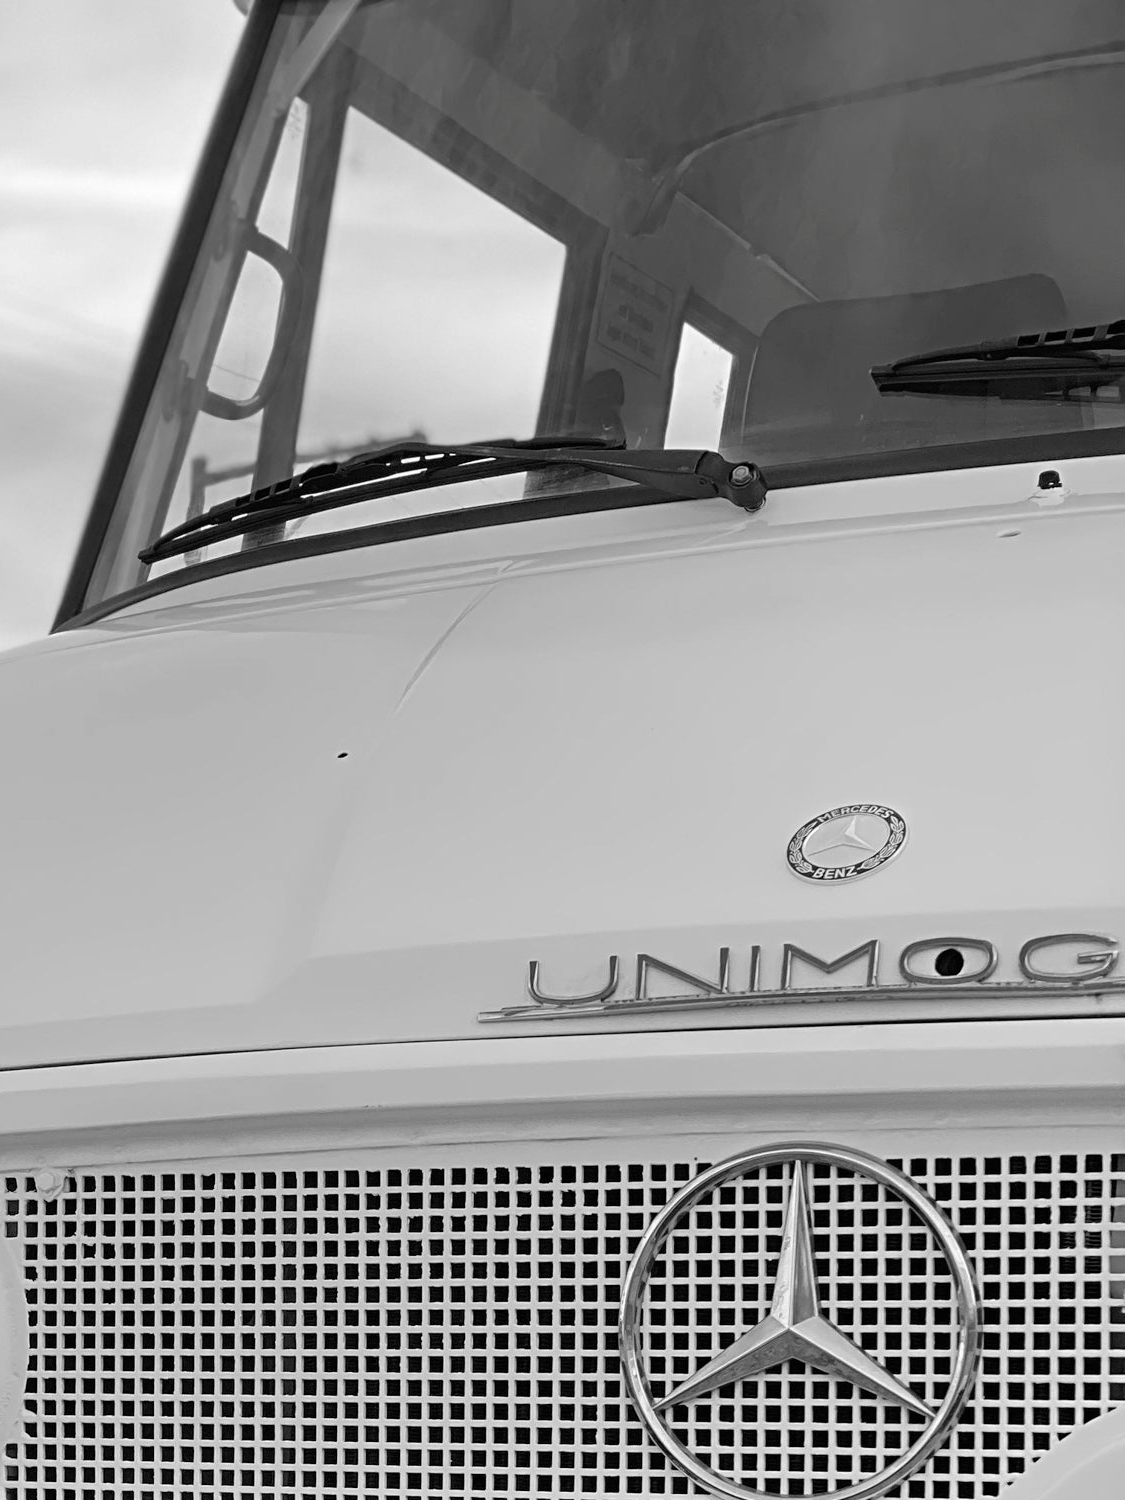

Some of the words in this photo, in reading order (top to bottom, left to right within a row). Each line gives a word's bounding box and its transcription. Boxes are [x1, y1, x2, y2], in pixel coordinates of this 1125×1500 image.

[817, 805, 894, 823] MERCEDES
[812, 866, 857, 879] BENZ
[529, 933, 1118, 1004] UNIMOG
